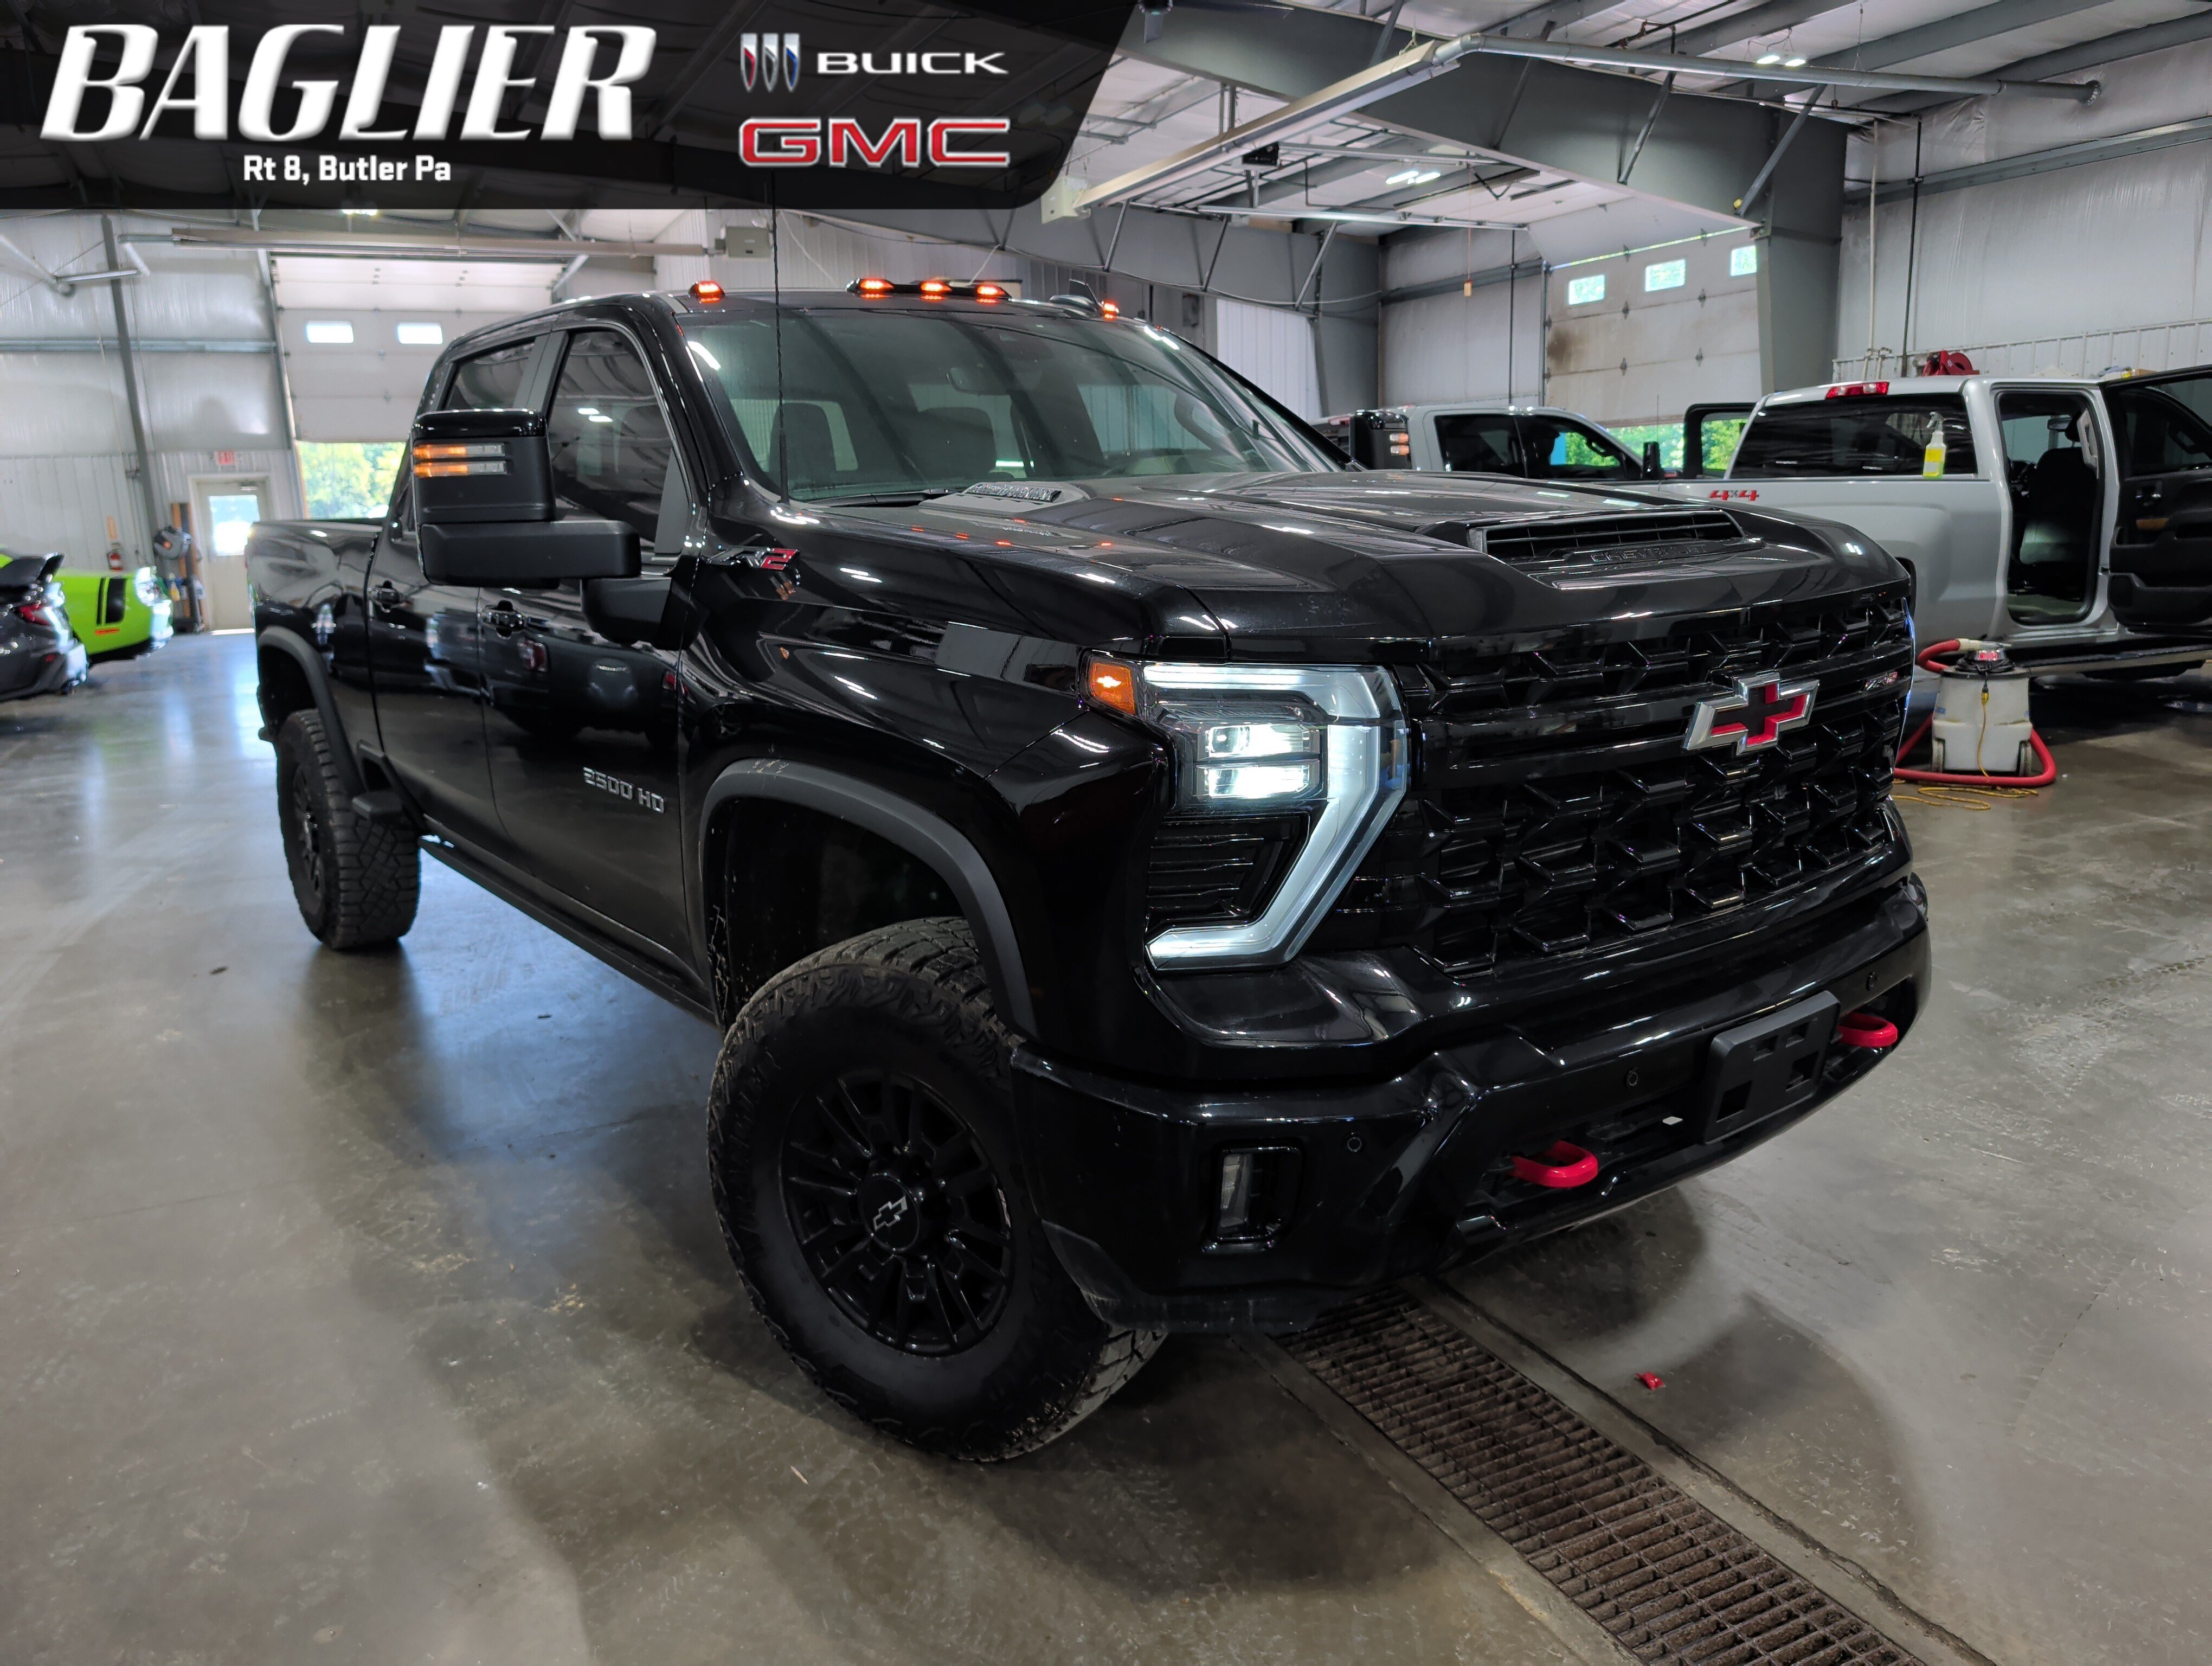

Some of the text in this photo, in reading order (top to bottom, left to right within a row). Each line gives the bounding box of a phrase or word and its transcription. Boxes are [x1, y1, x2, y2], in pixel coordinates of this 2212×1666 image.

[708, 547, 798, 570] ZR2
[583, 767, 665, 813] 2500 HD
